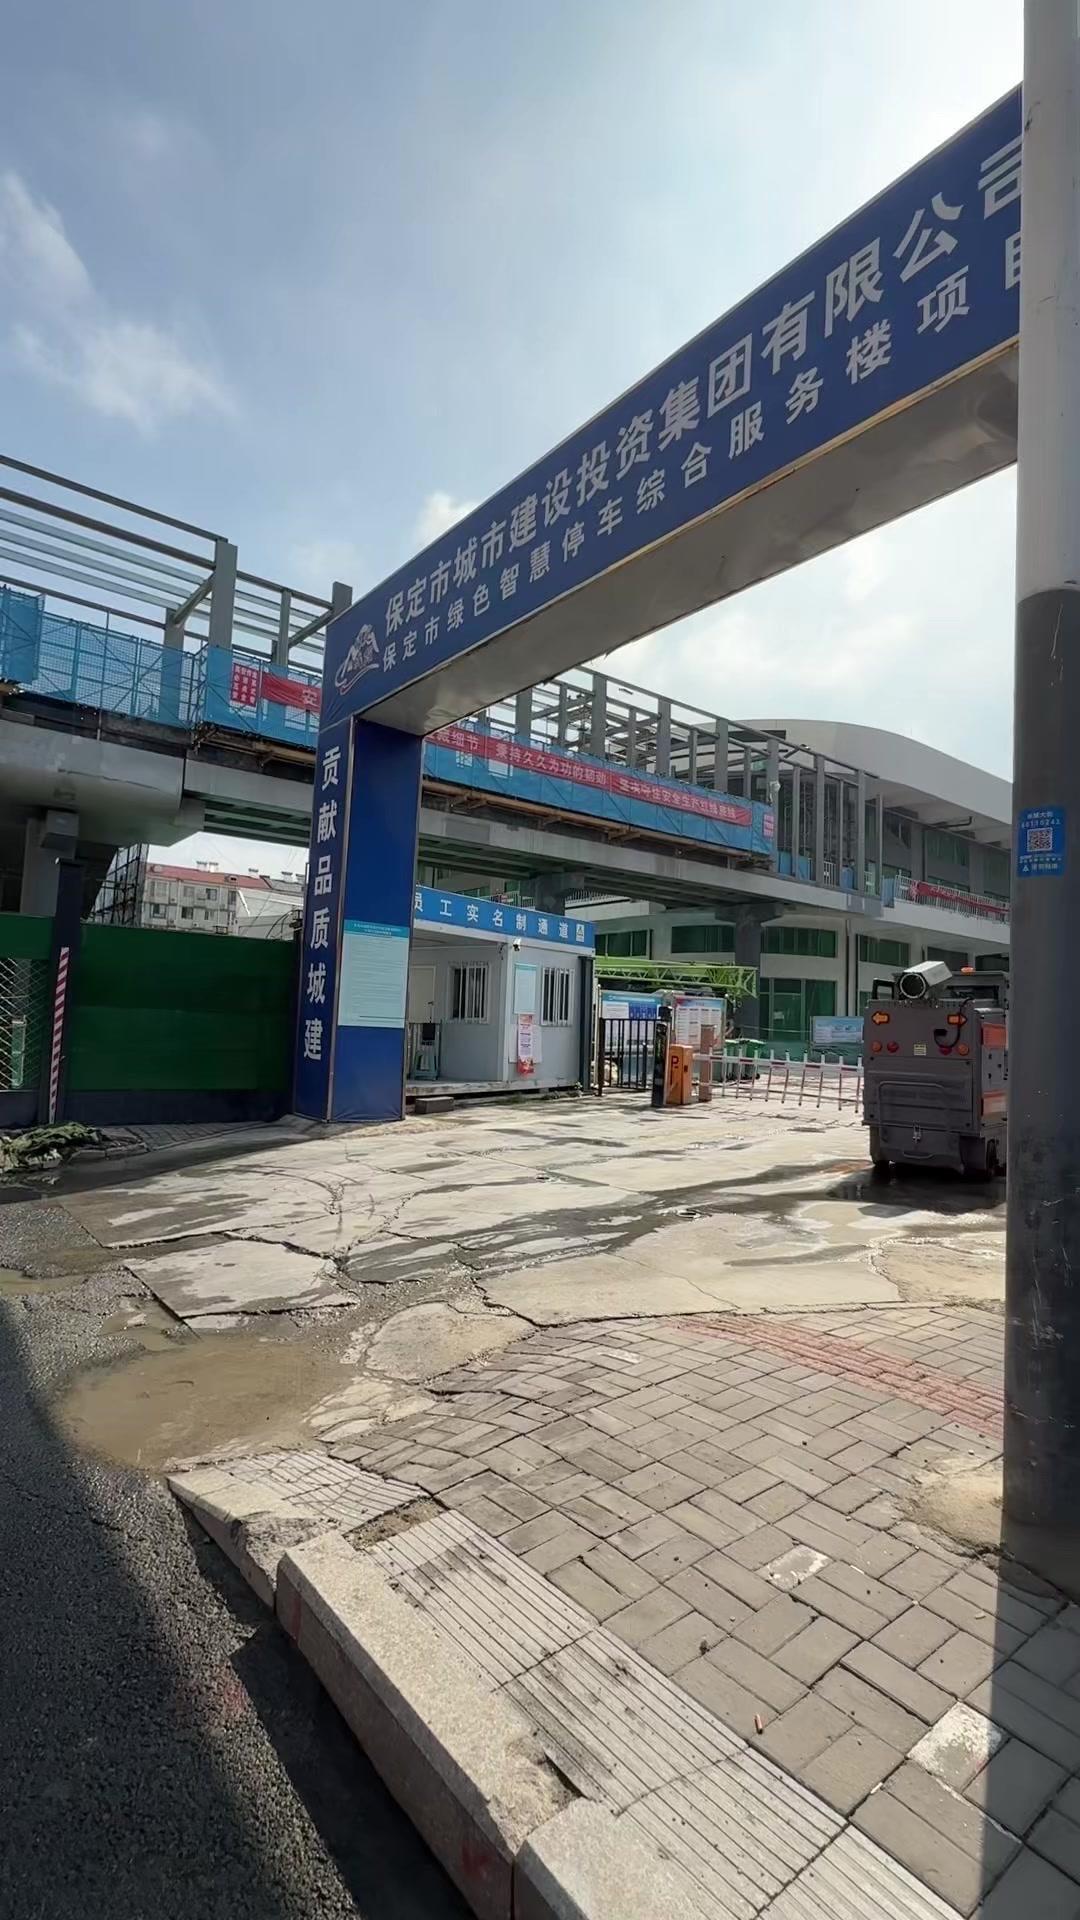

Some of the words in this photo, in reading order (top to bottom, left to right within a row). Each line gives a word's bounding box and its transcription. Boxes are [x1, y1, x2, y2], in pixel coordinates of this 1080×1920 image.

[385, 135, 1022, 637] 保定市城市建设投资集团有限公司
[303, 745, 342, 1061] 贡献品质城建
[414, 891, 569, 939] 员工实名制通道
